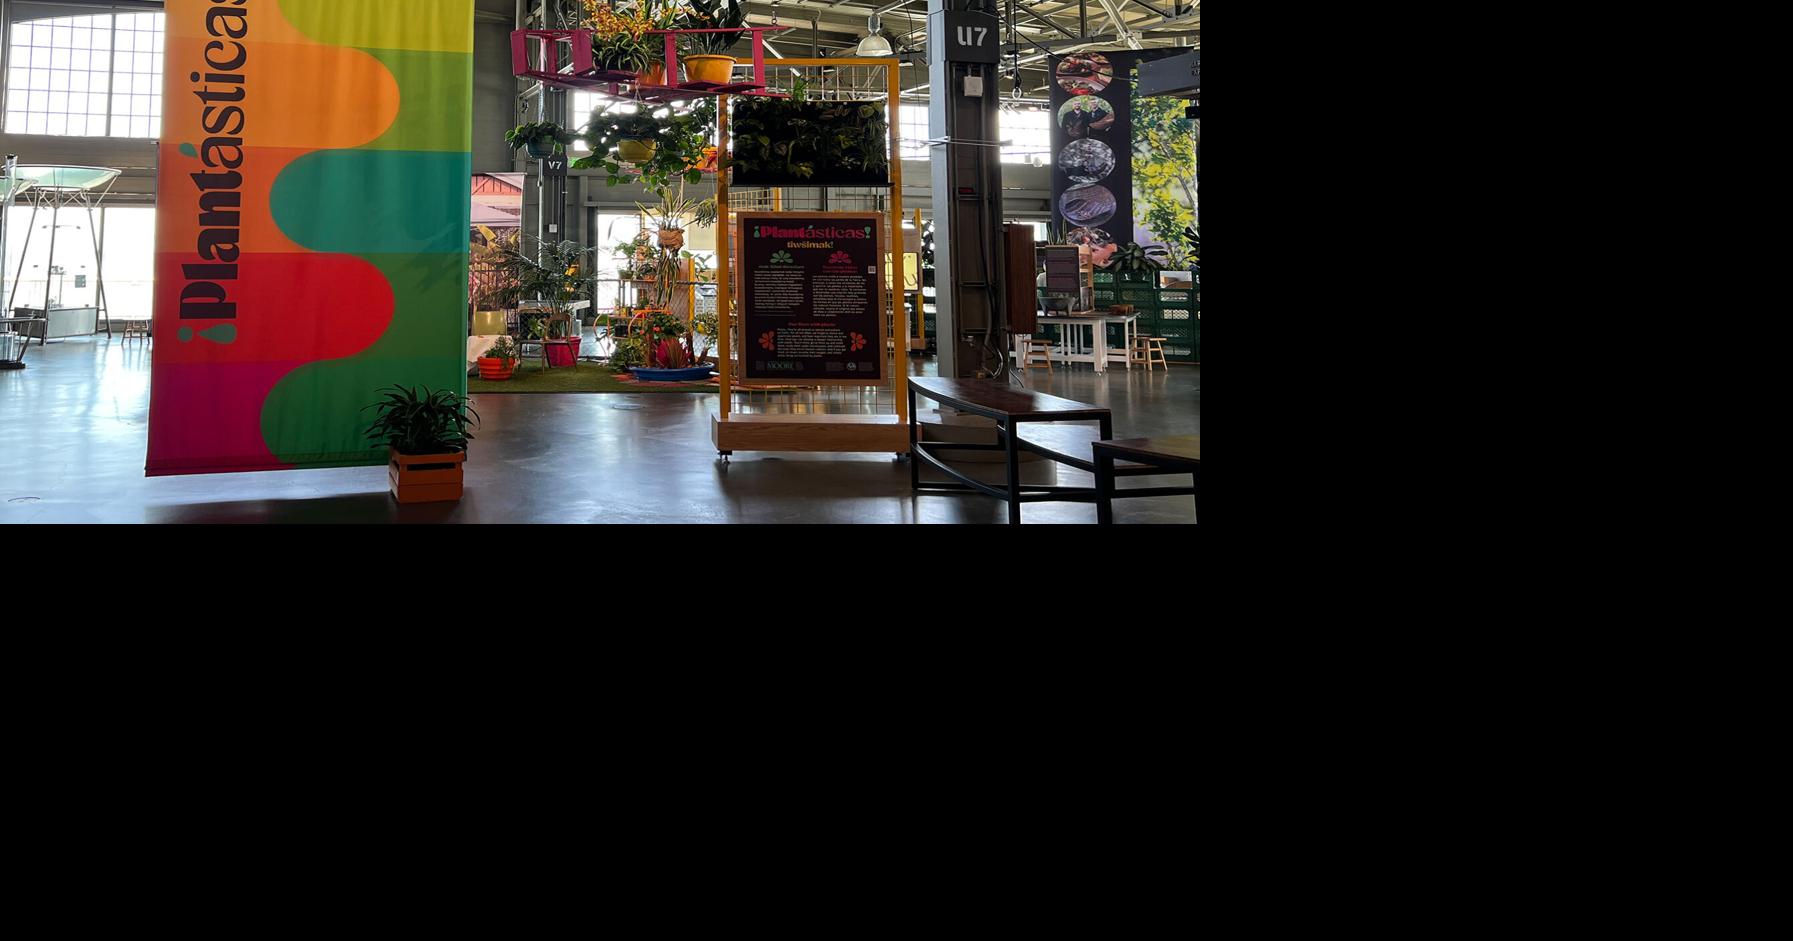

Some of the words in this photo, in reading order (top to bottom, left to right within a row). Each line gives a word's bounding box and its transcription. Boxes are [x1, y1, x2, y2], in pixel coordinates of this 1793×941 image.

[957, 26, 988, 47] U7
[177, 0, 248, 344] ¡Plantástica
[548, 161, 562, 170] V7
[753, 225, 871, 239] ¡Plantásticas!
